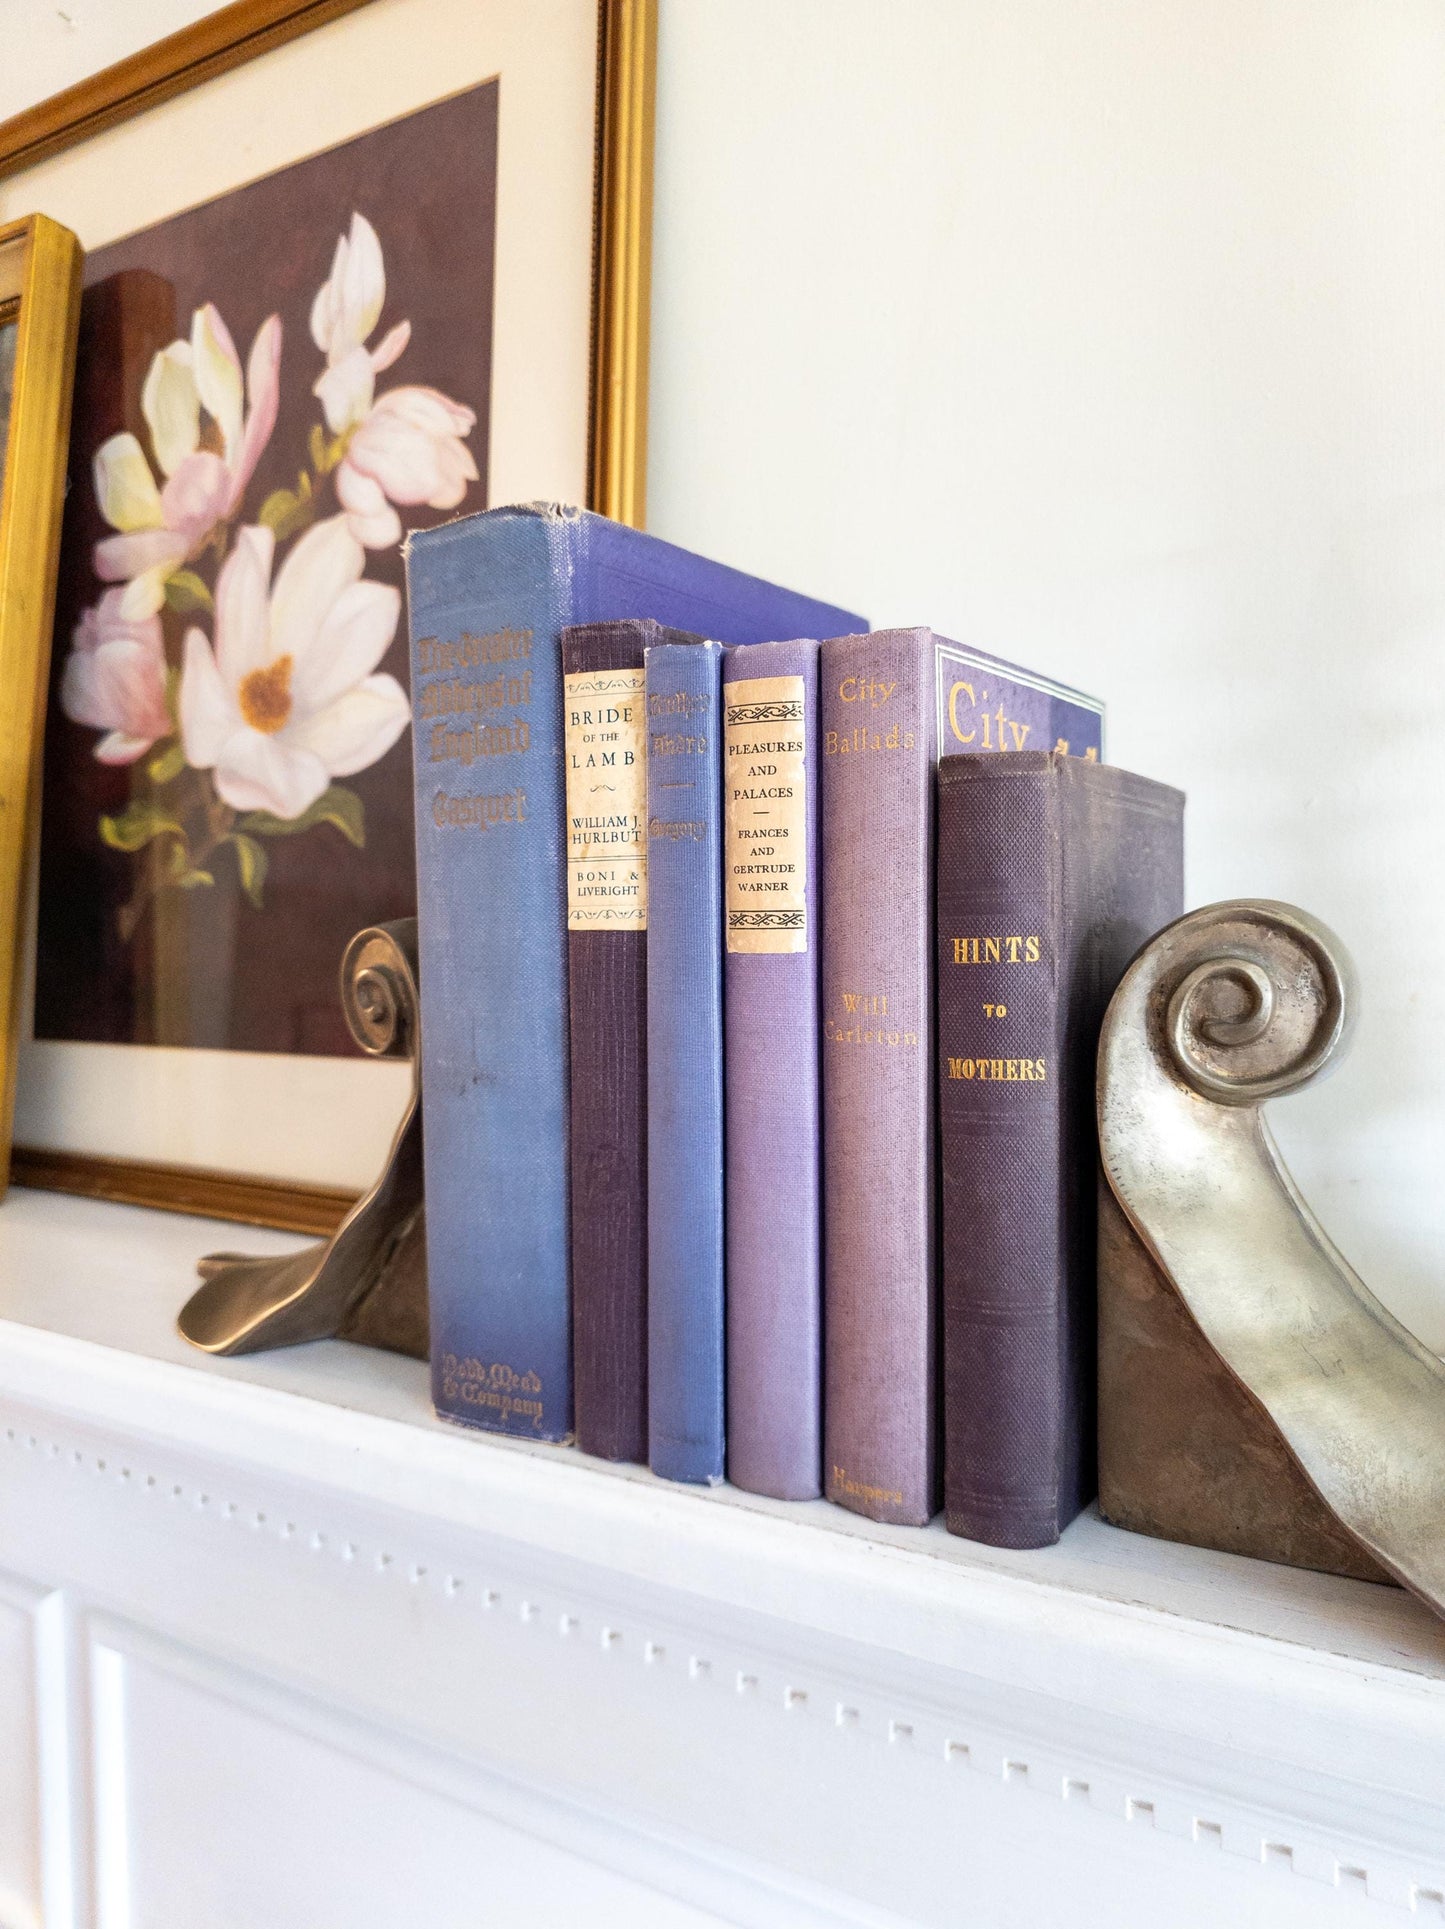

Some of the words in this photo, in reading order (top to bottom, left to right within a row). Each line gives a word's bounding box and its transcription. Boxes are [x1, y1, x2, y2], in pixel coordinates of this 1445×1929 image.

[418, 635, 457, 674] The
[508, 670, 533, 706] of
[839, 677, 897, 708] City
[570, 707, 634, 726] BRIDE
[948, 681, 1030, 752] City
[432, 718, 531, 766] England
[600, 732, 620, 742] THE
[825, 724, 915, 755] Ballads
[728, 741, 803, 756] PLEASURES
[571, 750, 636, 769] LAMB
[747, 765, 777, 776] AND
[733, 787, 794, 800] PALACES
[572, 816, 630, 829] WILLIAM
[633, 816, 642, 829] J.
[572, 831, 642, 844] HURLBUT
[738, 828, 789, 839] FRANCES
[750, 847, 775, 856] AND
[577, 871, 616, 882] BONI
[630, 871, 639, 881] &
[733, 864, 796, 875] GERTRUDE
[577, 885, 640, 897] LIVERIGHT
[738, 882, 789, 892] WARNER
[951, 936, 1041, 964] HINTS
[841, 992, 888, 1016] Will
[983, 1004, 1007, 1018] TO
[825, 1020, 919, 1046] Carleton
[948, 1057, 1046, 1081] MOTHERS
[461, 1382, 543, 1431] Company
